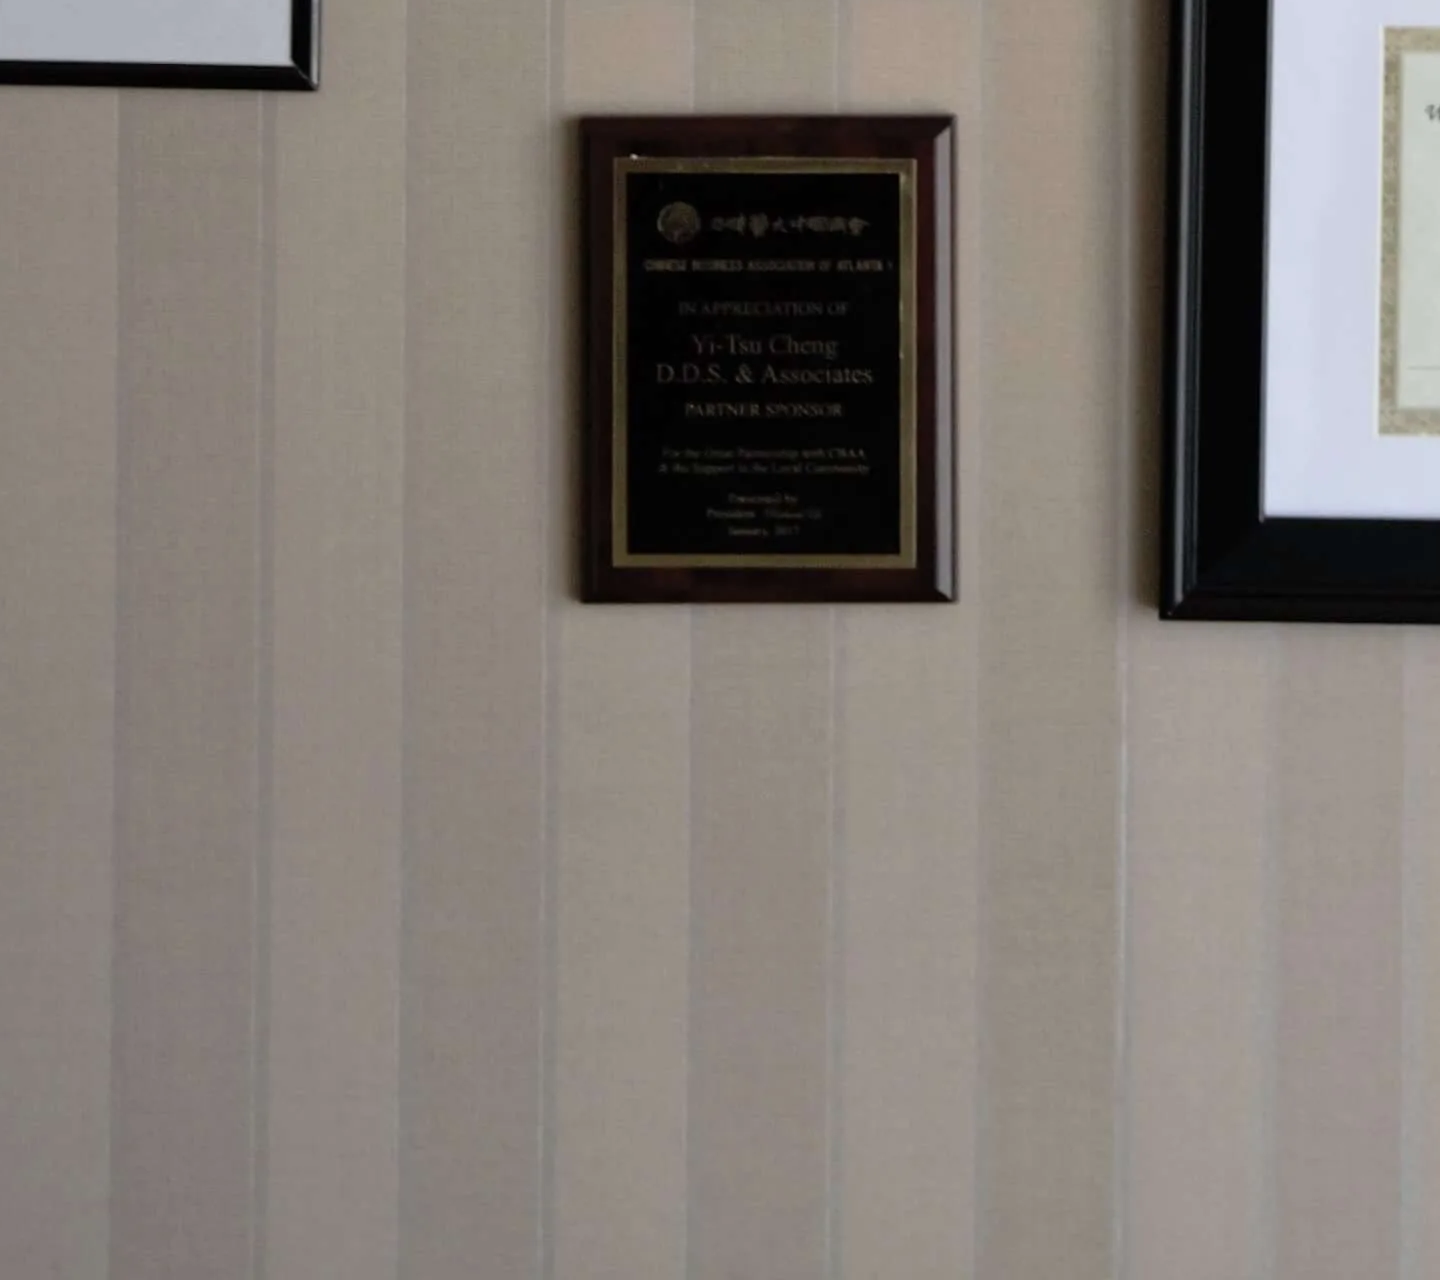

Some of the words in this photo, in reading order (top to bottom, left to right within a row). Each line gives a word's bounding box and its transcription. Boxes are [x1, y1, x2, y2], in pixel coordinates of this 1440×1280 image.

[690, 332, 762, 356] Yi-Tsu
[768, 333, 840, 361] Cheng
[735, 363, 754, 384] &
[763, 364, 874, 385] Associates
